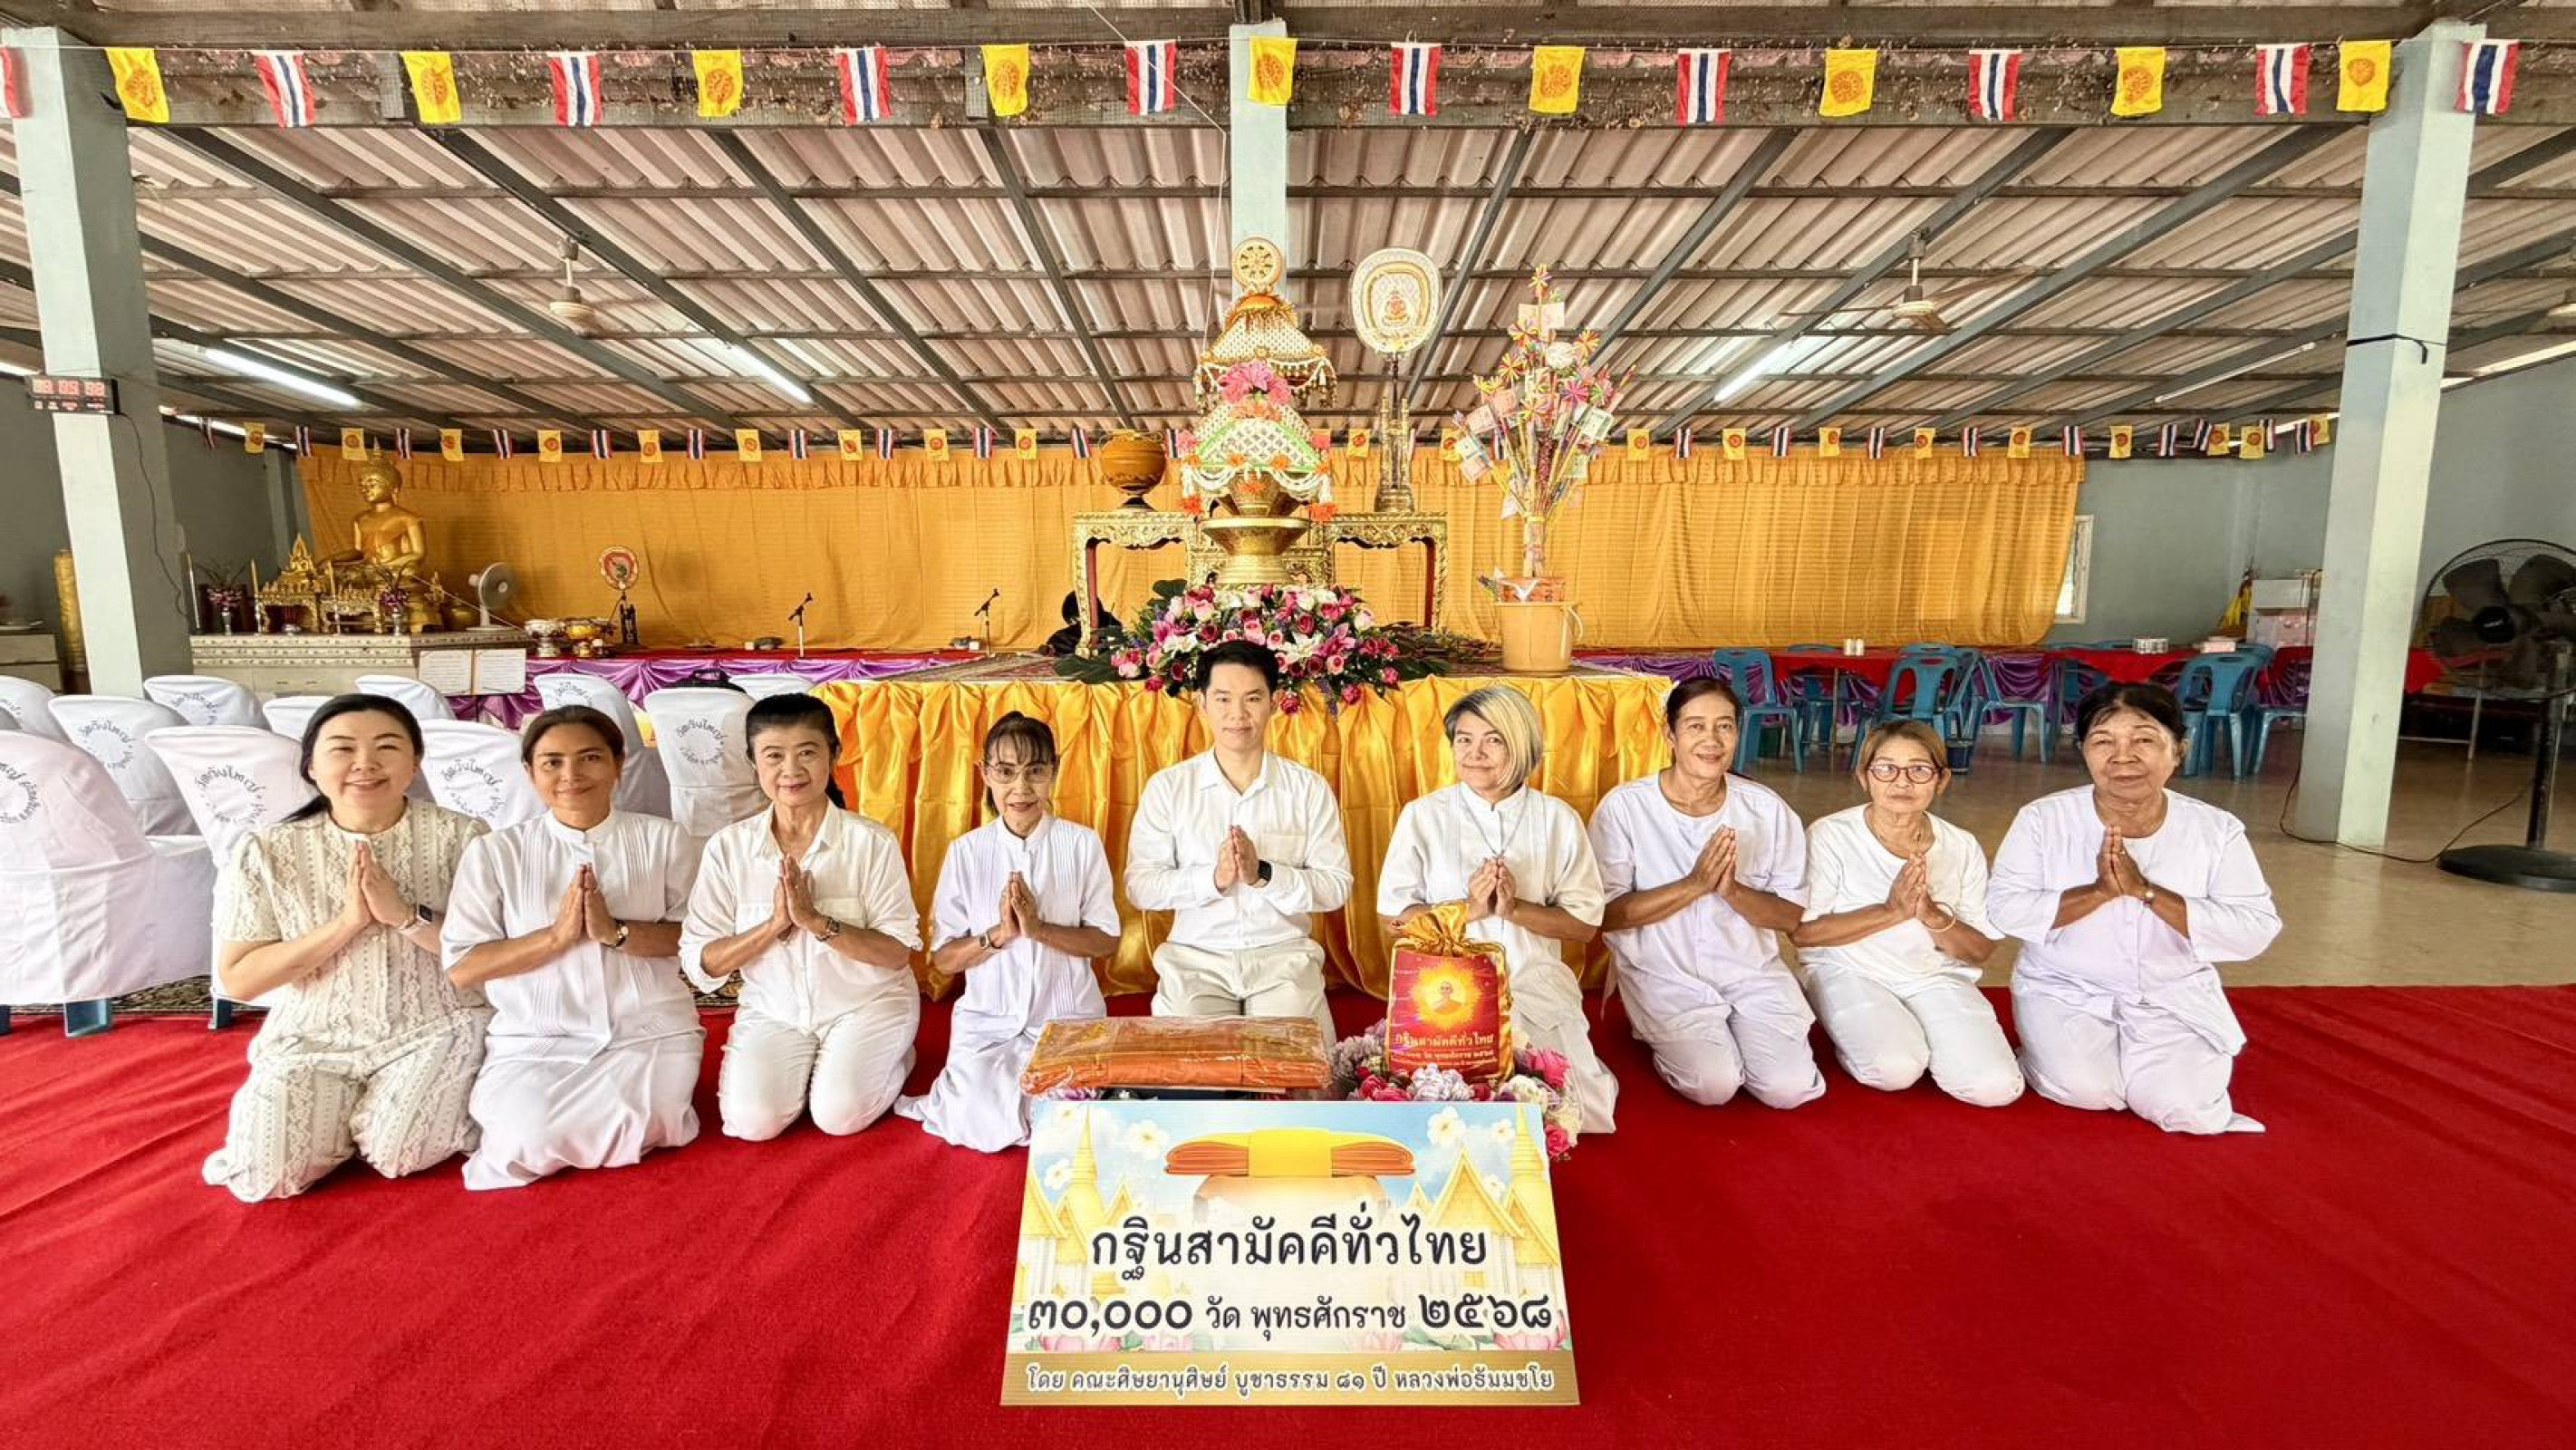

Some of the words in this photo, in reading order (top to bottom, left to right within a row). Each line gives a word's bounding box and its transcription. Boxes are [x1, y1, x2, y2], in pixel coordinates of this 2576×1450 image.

[1092, 1202, 1487, 1281] กฐินสามัคคีทั่วไทย
[1028, 1300, 1192, 1337] ๓๐,๐๐๐
[1205, 1295, 1241, 1329] วัด
[1251, 1295, 1406, 1342] พุทธศักราช
[1418, 1292, 1552, 1329] ๒๕๖๘
[1028, 1366, 1064, 1389] โดย
[1072, 1364, 1228, 1397] คณะศิษยานุศิษย์
[1235, 1371, 1329, 1397] บูชาธรรม
[1336, 1373, 1365, 1390] ๘๑
[1372, 1366, 1386, 1388] ปี
[1395, 1365, 1552, 1388] หลวงพ่อธัมมชโย
